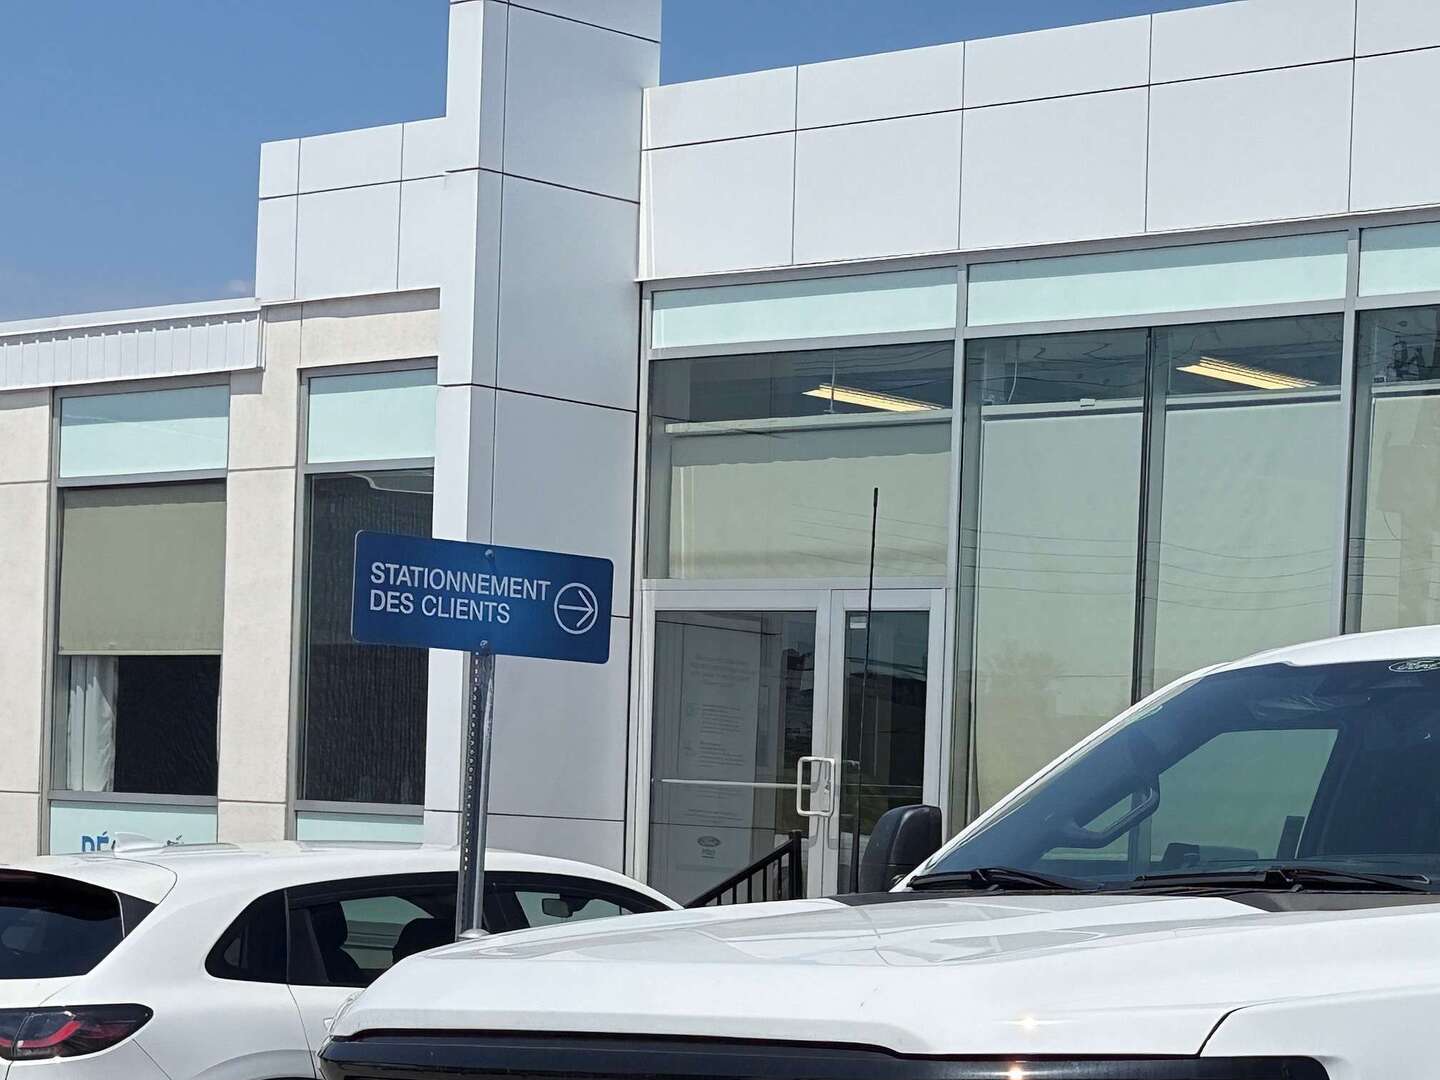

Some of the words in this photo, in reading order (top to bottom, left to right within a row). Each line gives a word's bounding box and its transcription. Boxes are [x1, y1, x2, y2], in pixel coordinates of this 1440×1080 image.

[370, 561, 551, 601] STATIONNEMENT
[370, 589, 414, 614] DES
[421, 594, 511, 624] CLIENTS
